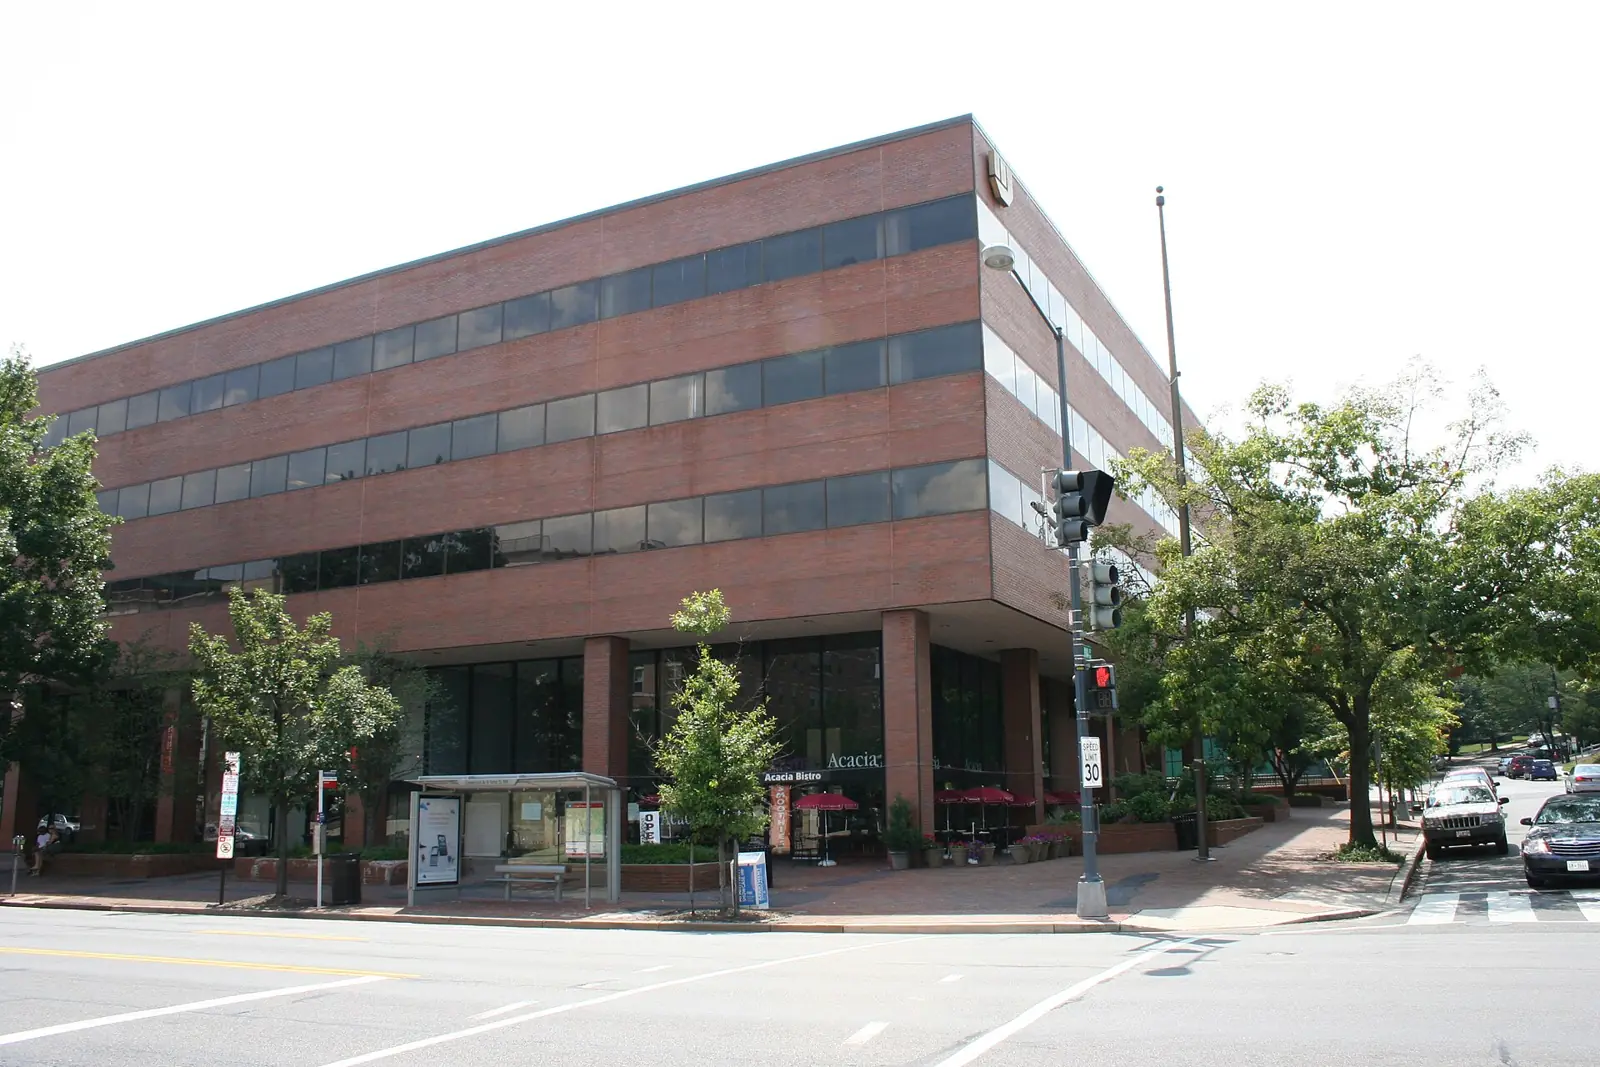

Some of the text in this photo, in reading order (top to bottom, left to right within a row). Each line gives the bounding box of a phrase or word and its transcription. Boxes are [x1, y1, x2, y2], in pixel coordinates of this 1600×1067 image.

[1083, 743, 1098, 751] SPEED
[827, 752, 880, 768] Acacia
[1085, 753, 1098, 761] LIMIT
[764, 771, 822, 782] Acacia Bistro
[1085, 764, 1099, 781] 30
